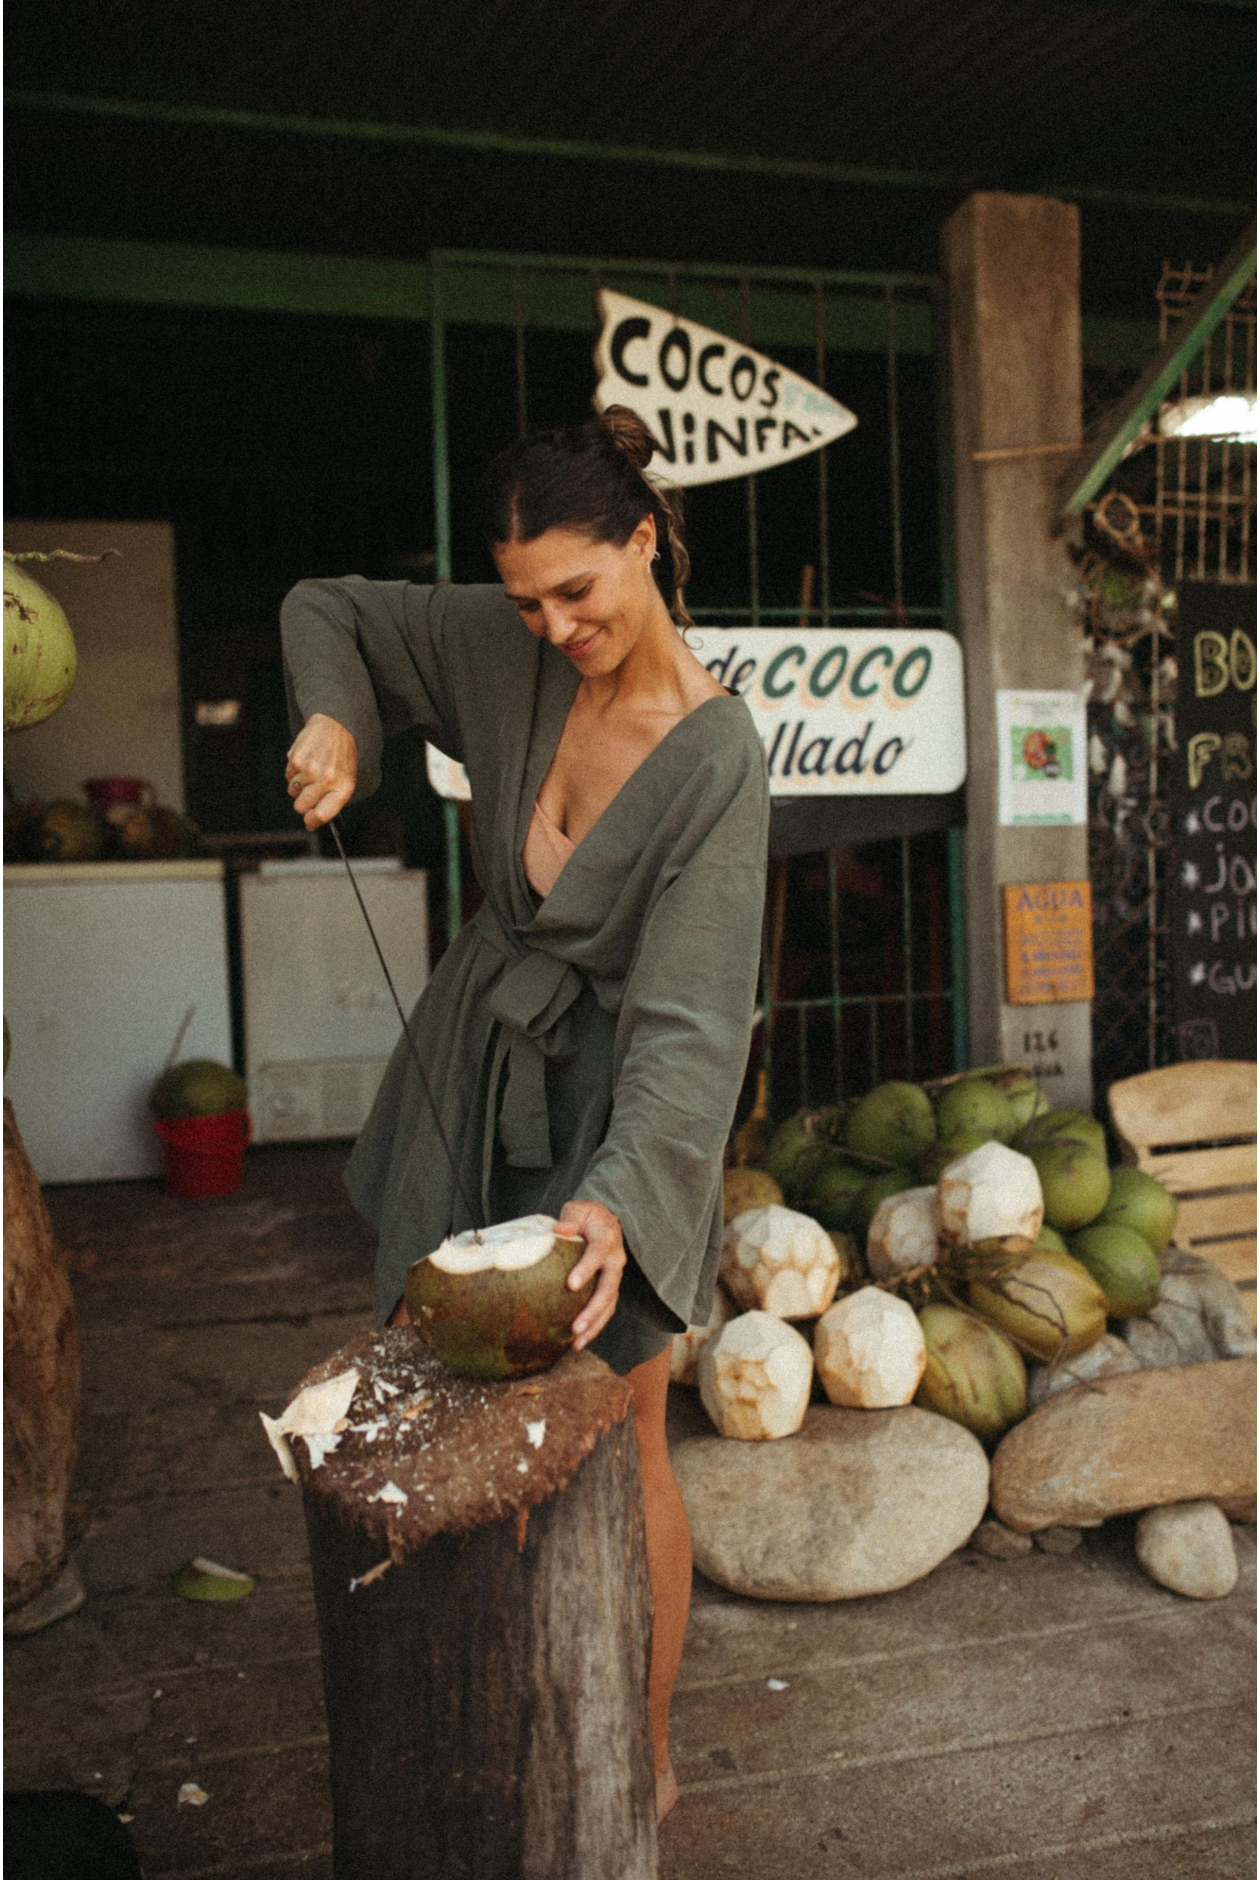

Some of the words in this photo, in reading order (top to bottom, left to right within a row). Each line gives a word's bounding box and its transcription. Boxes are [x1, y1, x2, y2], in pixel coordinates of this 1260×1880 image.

[611, 317, 780, 408] COCOS
[705, 645, 756, 696] de
[762, 644, 932, 698] COCO
[763, 720, 908, 777] llado
[1203, 796, 1257, 832] CO
[1016, 887, 1085, 912] AGUA
